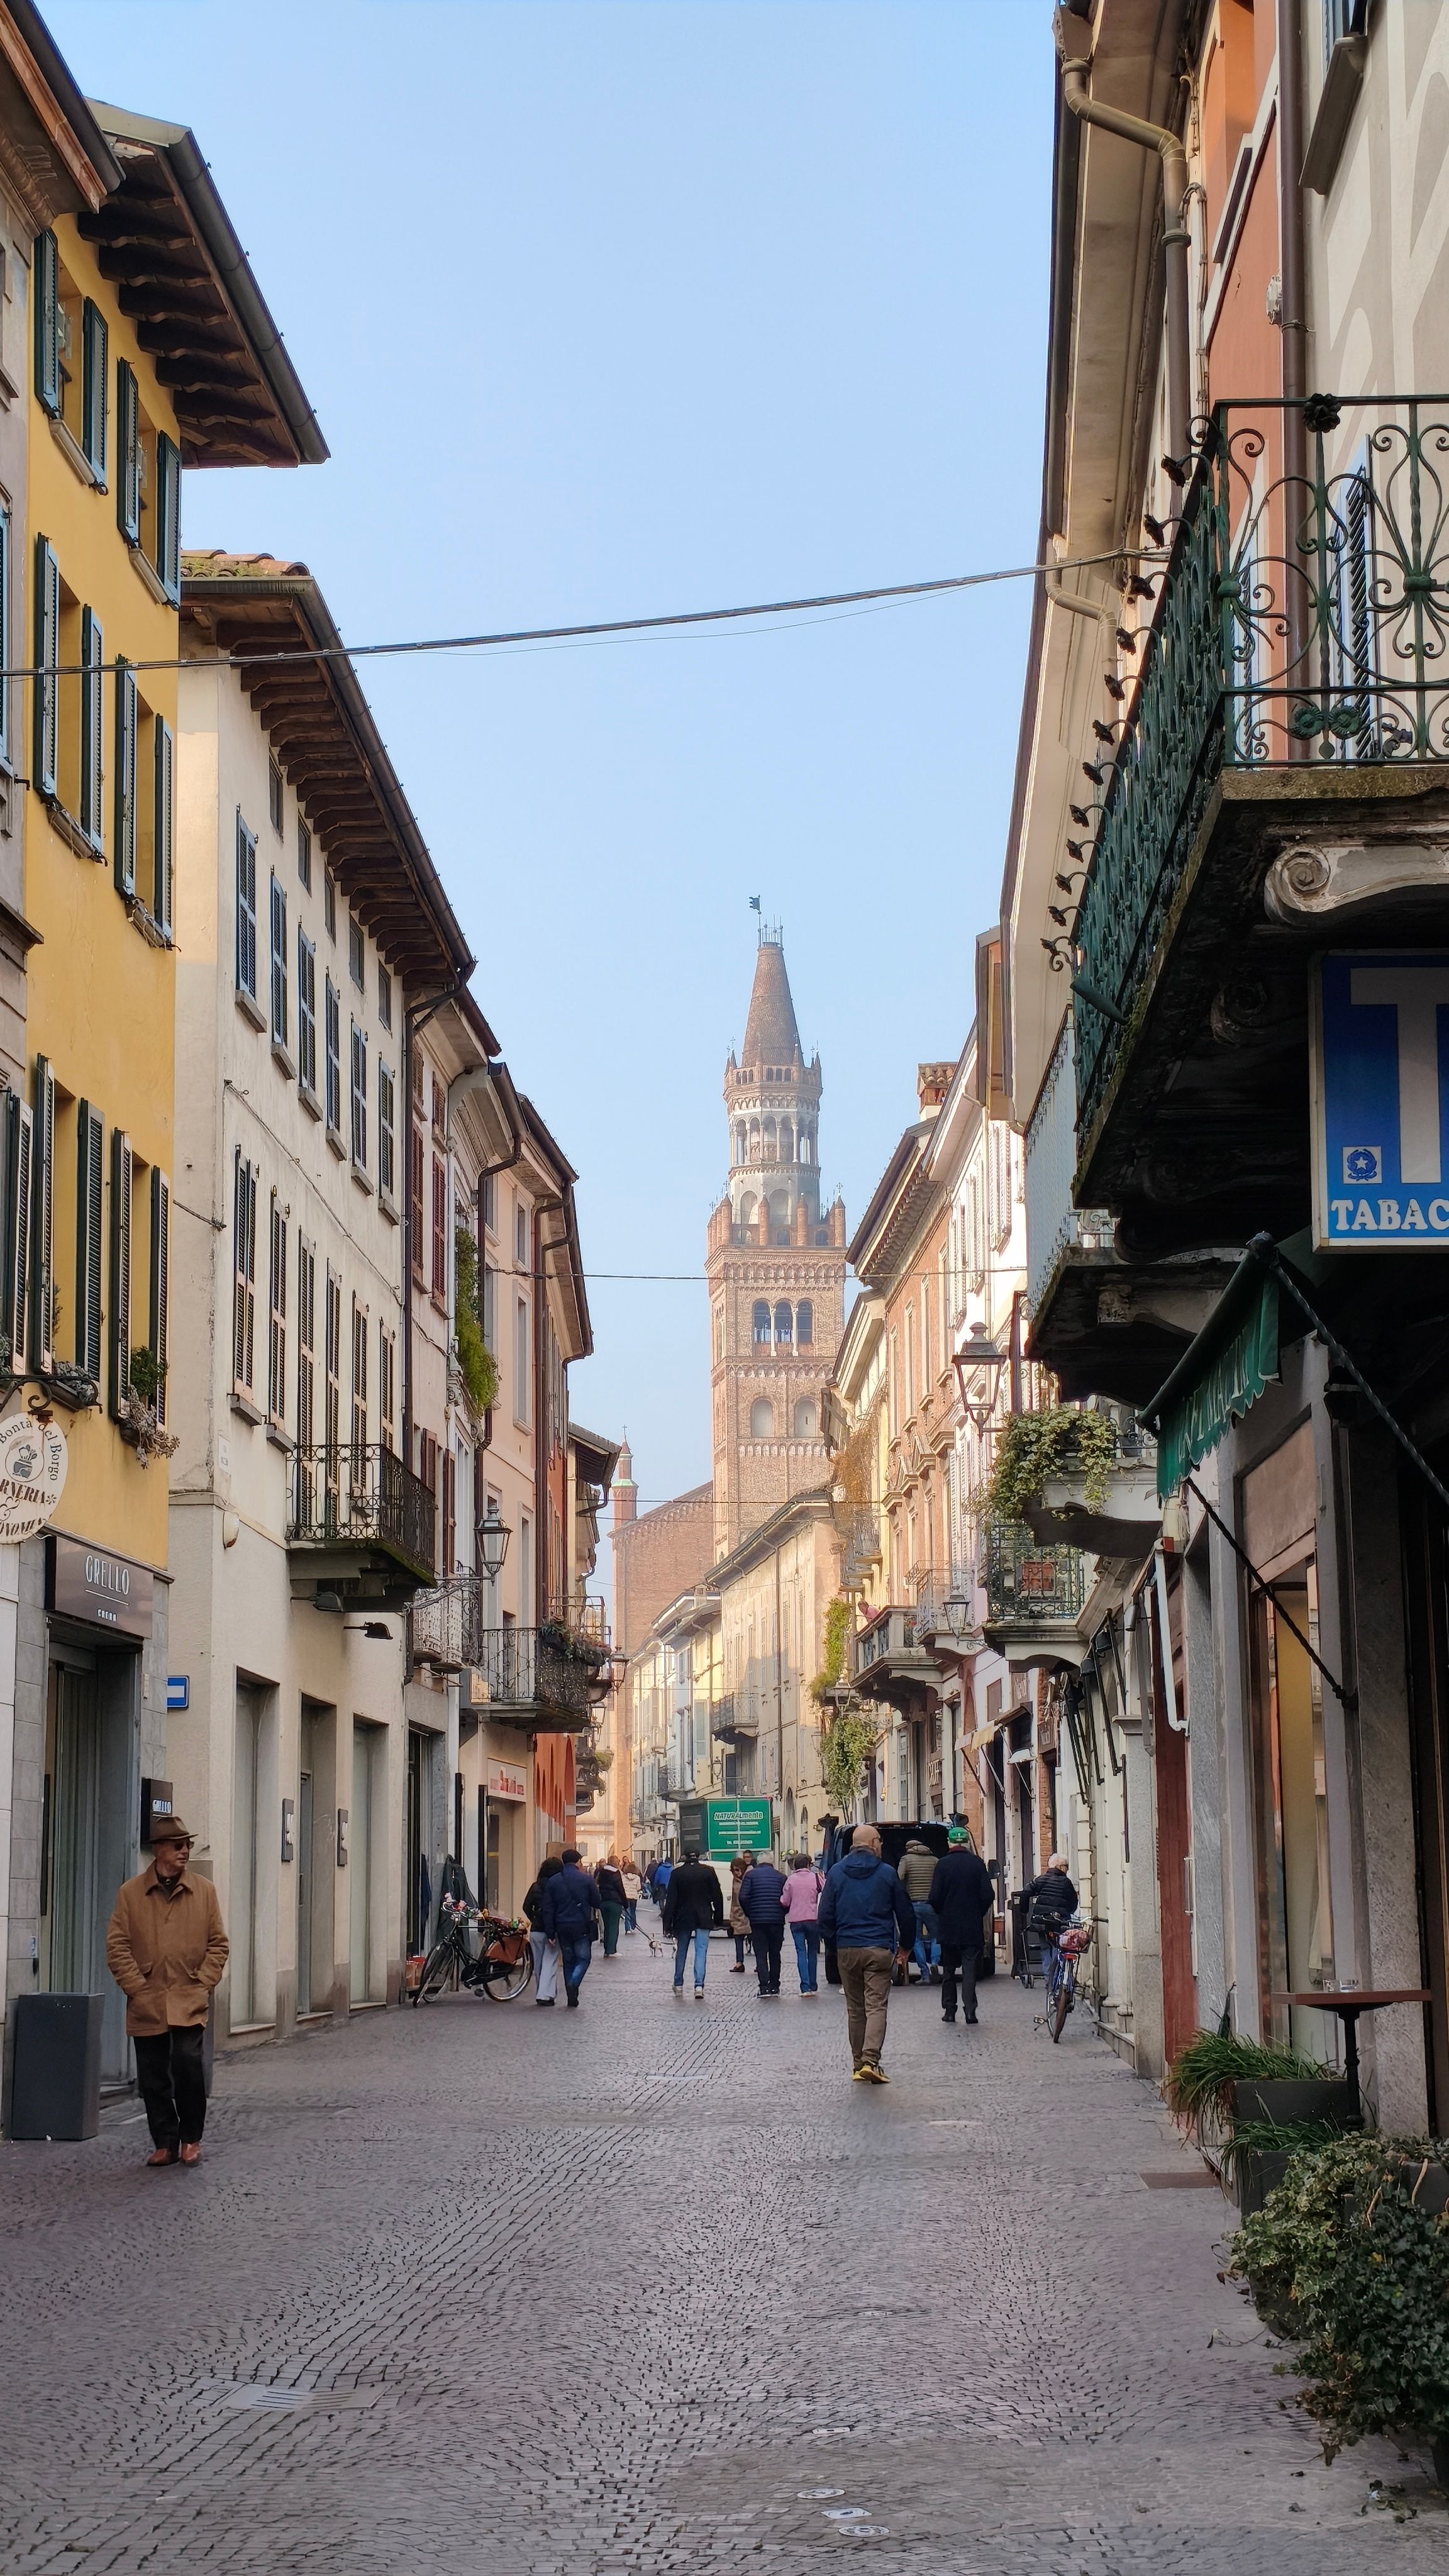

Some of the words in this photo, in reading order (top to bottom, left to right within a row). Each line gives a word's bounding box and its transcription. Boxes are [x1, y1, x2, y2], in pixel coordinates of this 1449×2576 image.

[1350, 967, 1449, 1184] T
[1331, 1198, 1449, 1231] TABAC
[48, 1444, 62, 1481] Borgo
[85, 1555, 130, 1595] GRELLO
